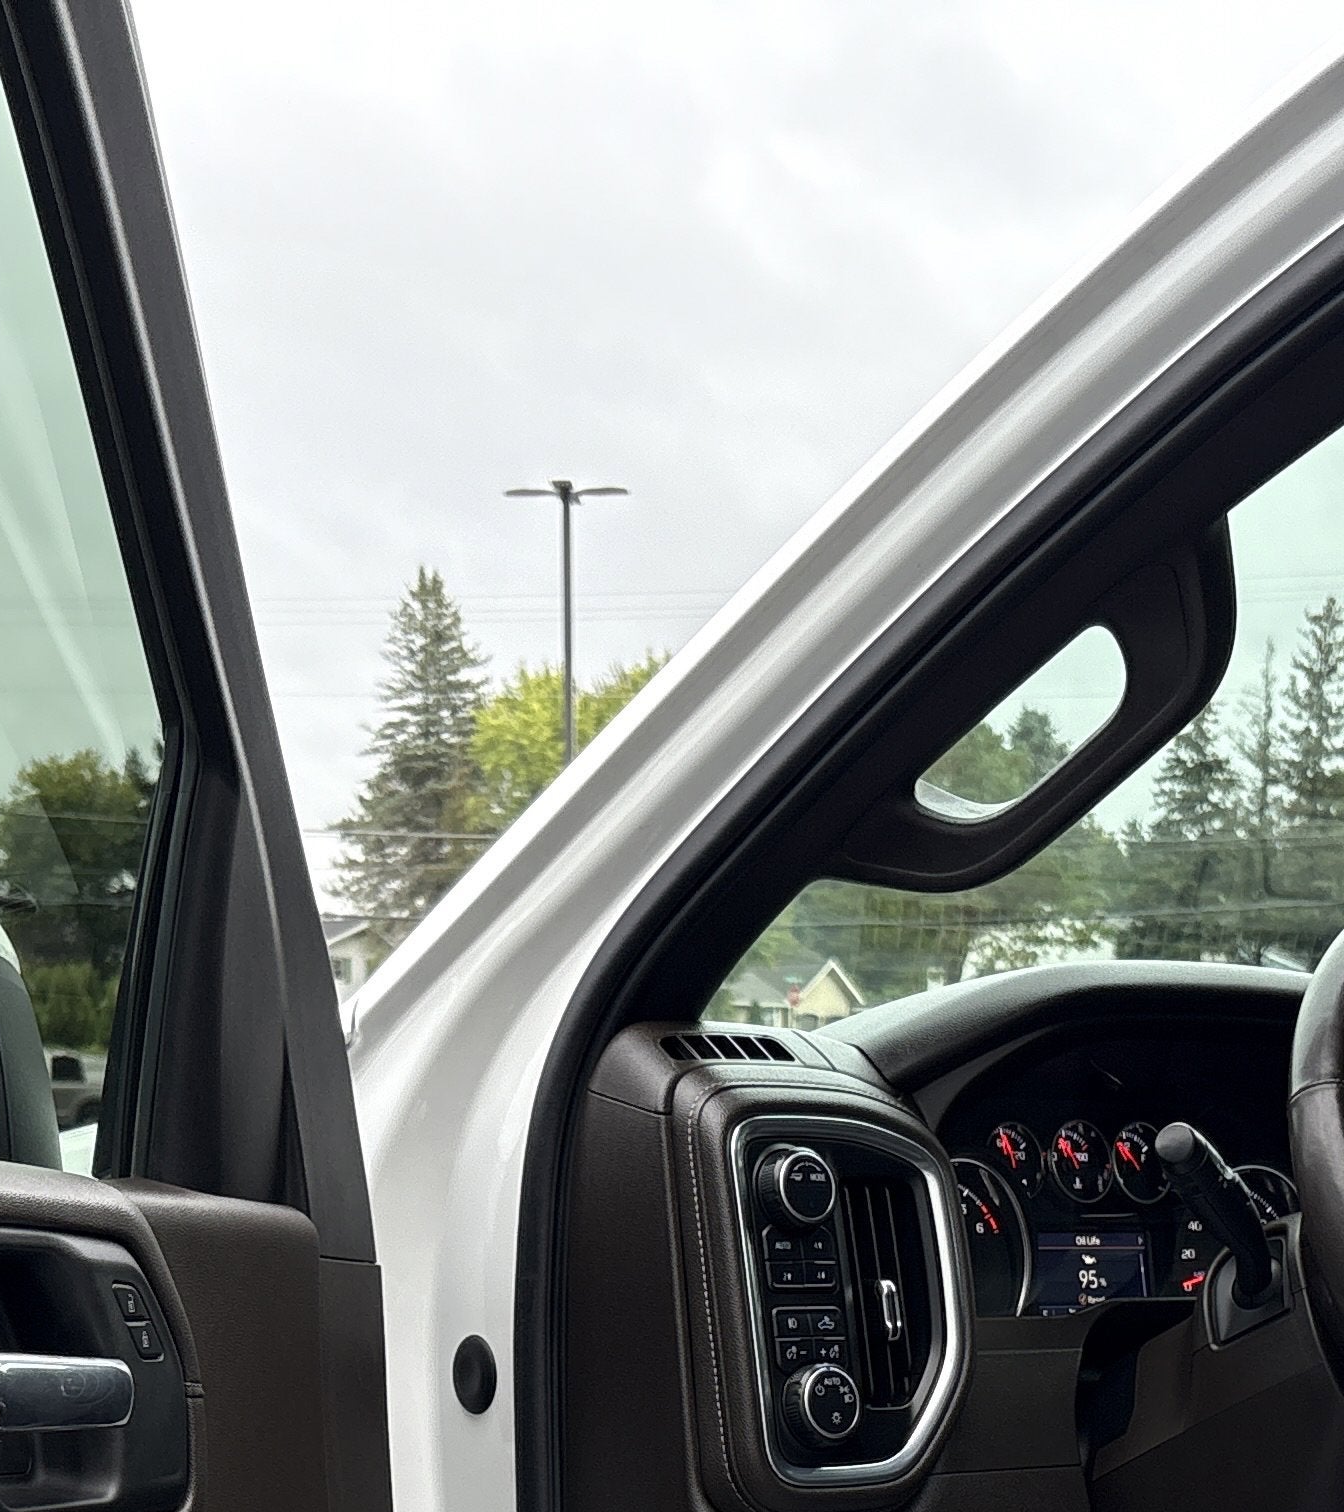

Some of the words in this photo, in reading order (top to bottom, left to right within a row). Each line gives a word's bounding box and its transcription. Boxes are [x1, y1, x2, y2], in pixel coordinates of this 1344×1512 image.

[1187, 1220, 1203, 1232] 40
[1180, 1248, 1196, 1260] 20
[823, 1376, 842, 1387] AUTO
